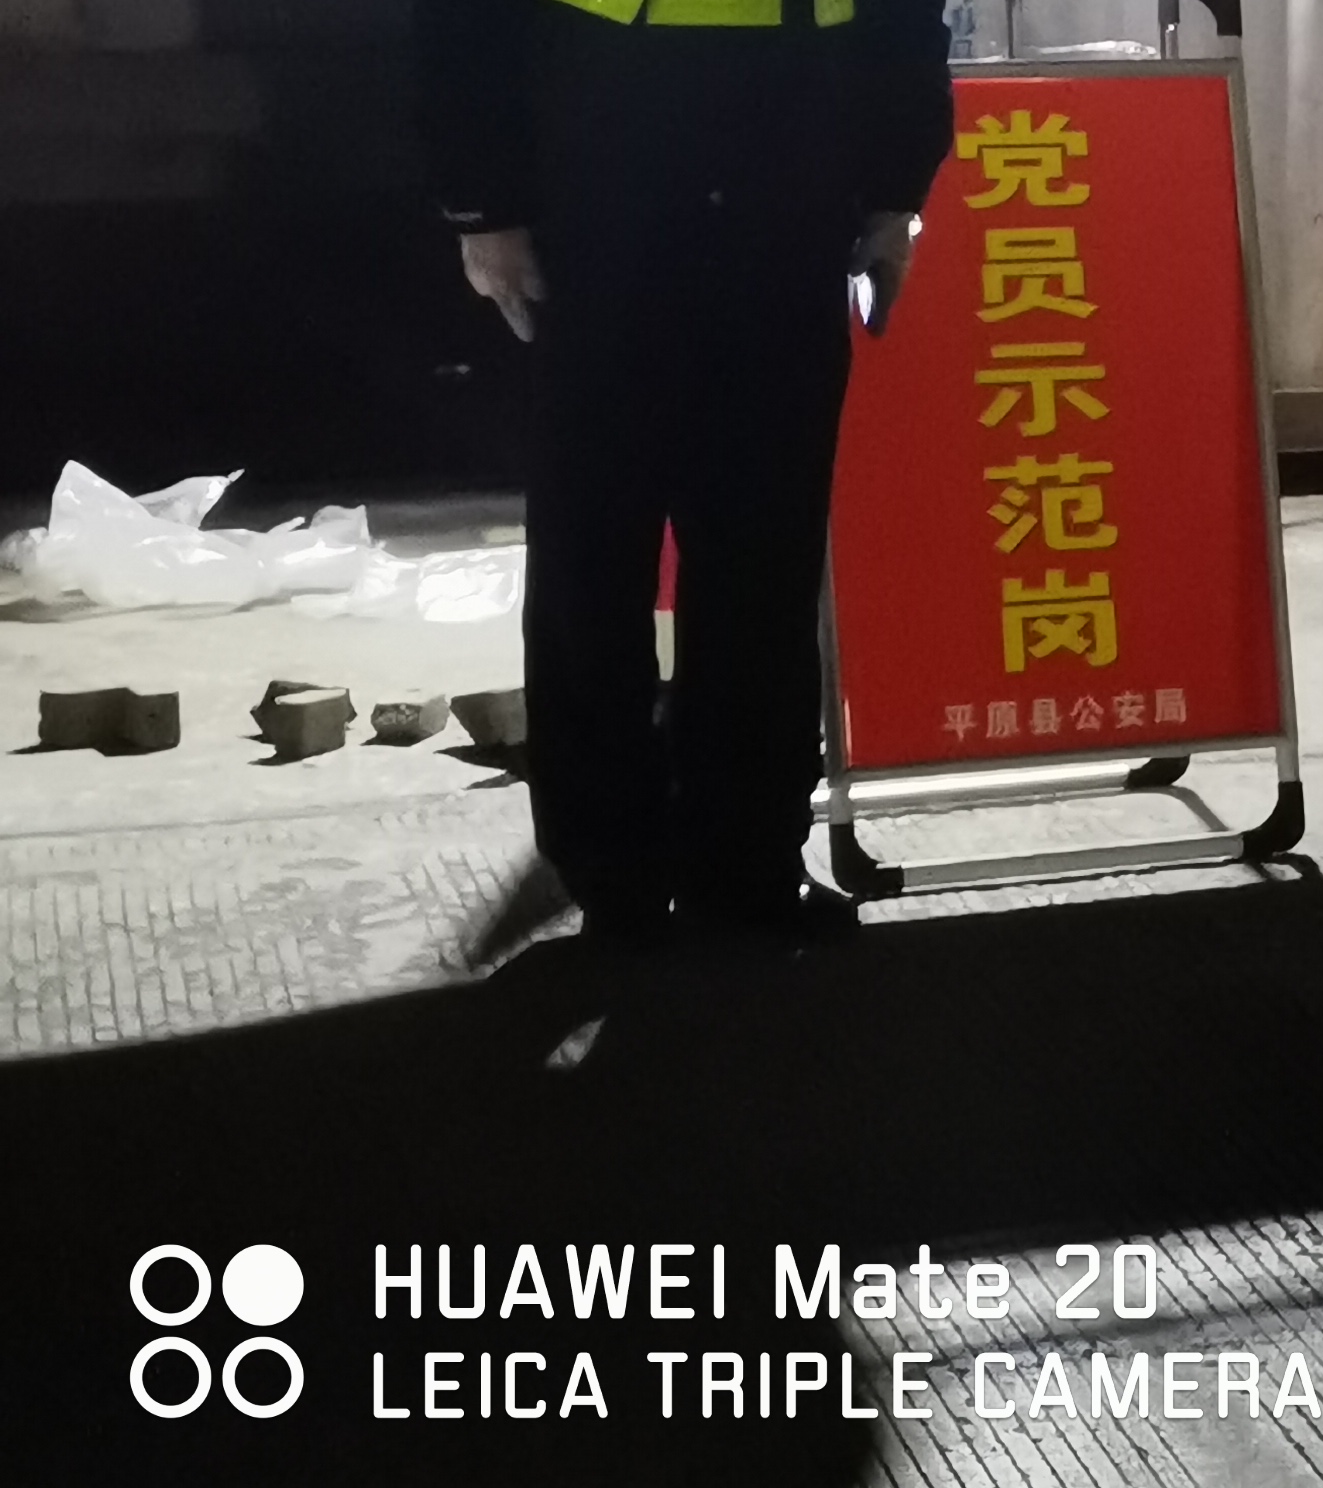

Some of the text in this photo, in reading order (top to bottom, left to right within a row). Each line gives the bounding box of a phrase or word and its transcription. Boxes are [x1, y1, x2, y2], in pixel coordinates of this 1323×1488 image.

[955, 109, 1120, 674] 党员示范岗
[943, 687, 1188, 743] 平原县公安局
